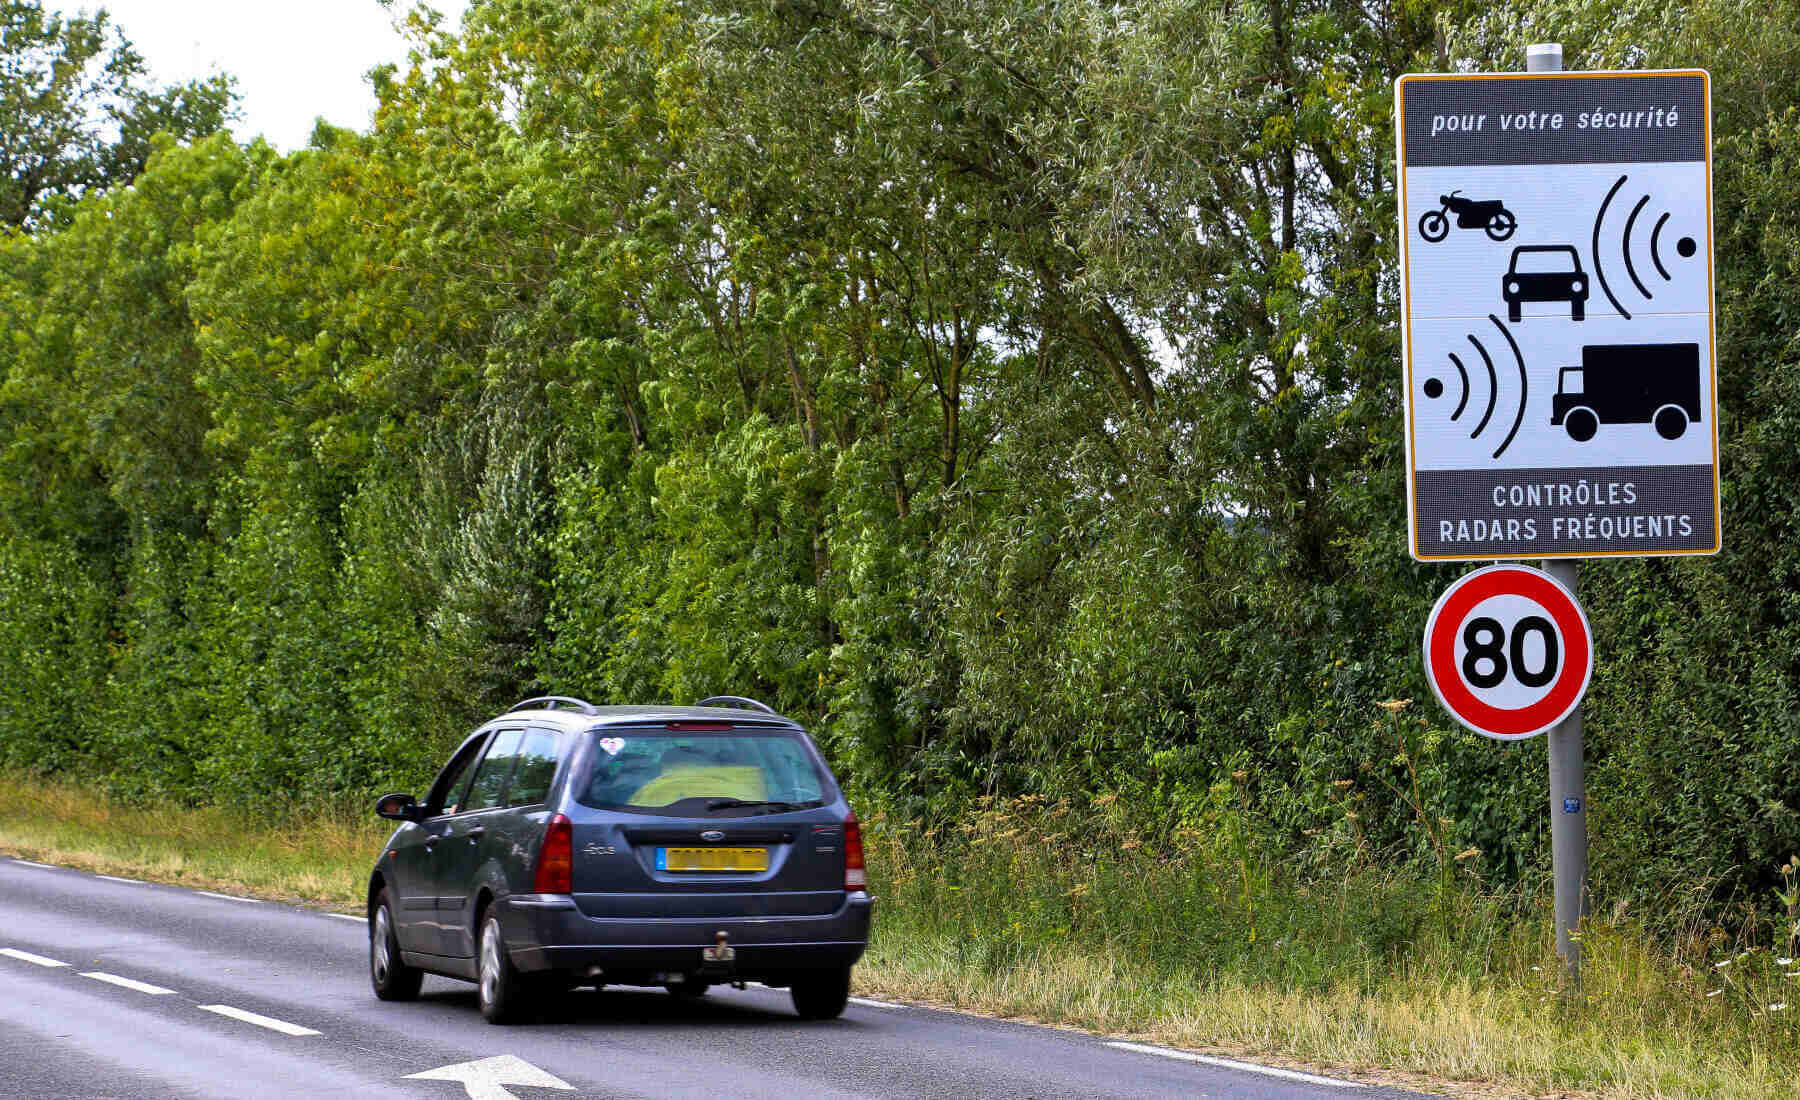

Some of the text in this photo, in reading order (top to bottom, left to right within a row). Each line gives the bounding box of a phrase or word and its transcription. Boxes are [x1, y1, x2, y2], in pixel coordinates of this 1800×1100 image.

[1431, 105, 1679, 136] pour votre sécurité
[1493, 479, 1637, 506] CONTRÔLES
[1440, 512, 1692, 542] RADARS FRÉQUENTS
[1462, 616, 1558, 689] 80
